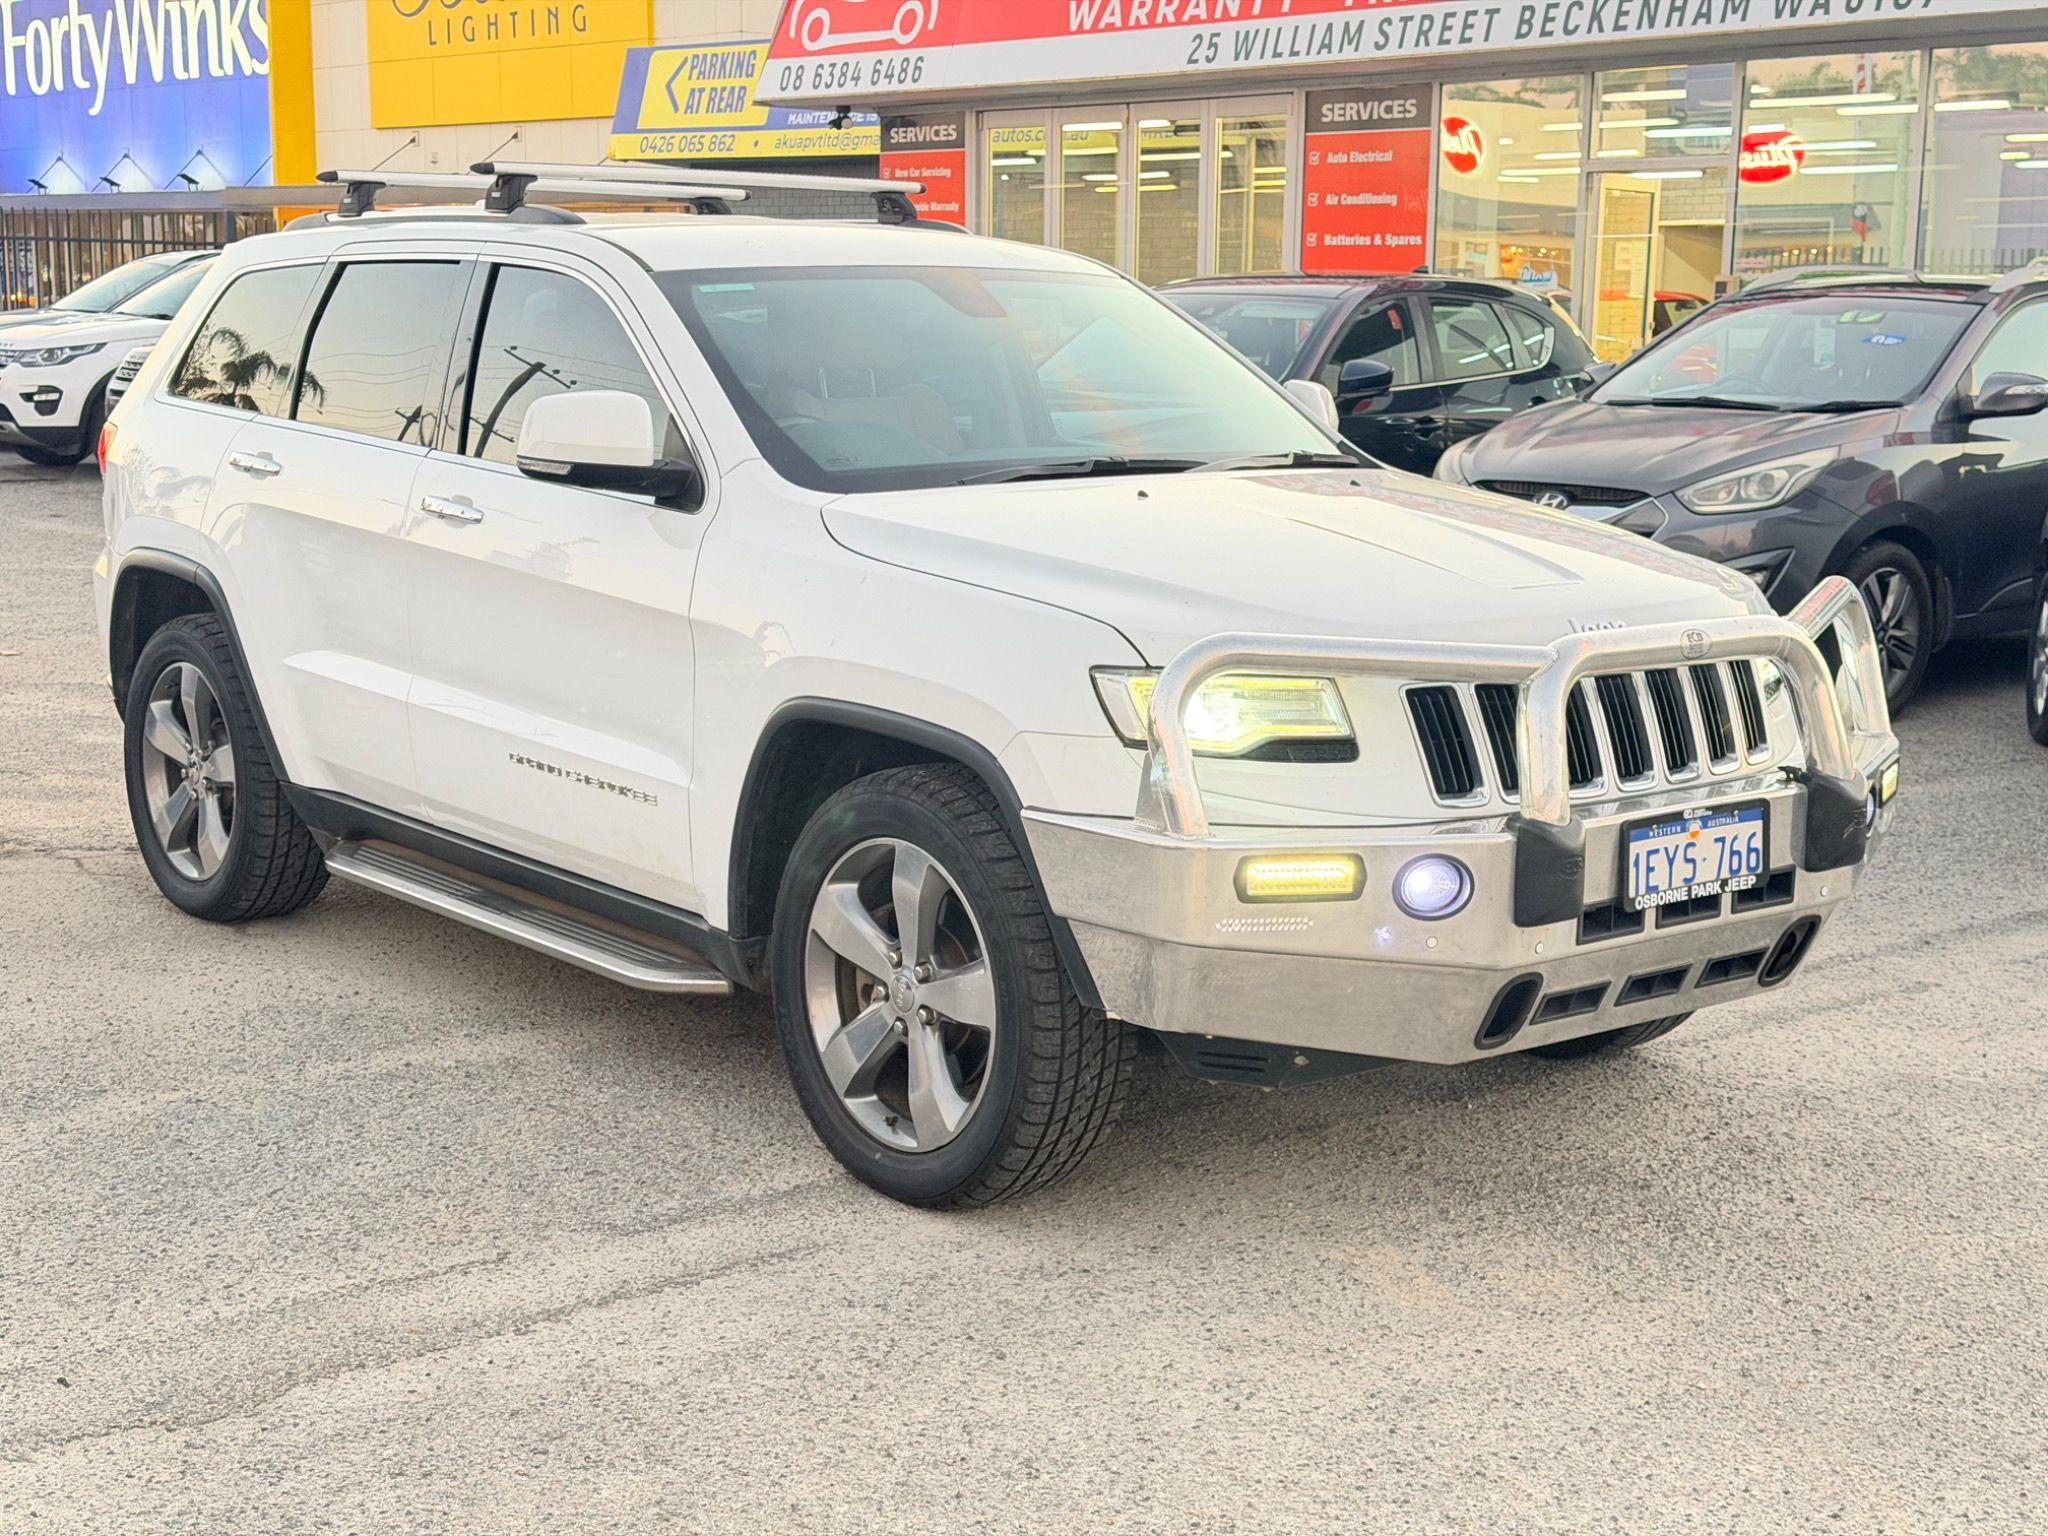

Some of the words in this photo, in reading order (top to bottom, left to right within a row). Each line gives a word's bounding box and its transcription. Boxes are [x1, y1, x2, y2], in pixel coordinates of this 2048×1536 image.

[428, 4, 587, 46] LIGHTING
[1187, 32, 1221, 65] 25
[1233, 19, 1365, 62] WILLIAM
[1373, 8, 1501, 51] STREET
[1514, 0, 1752, 39] BECKENHAM
[688, 50, 757, 81] PARKING
[780, 64, 805, 91] 08
[812, 60, 862, 89] 6384
[870, 56, 924, 86] 6486
[684, 88, 705, 114] AT
[706, 86, 747, 113] REAR
[1321, 99, 1417, 122] SERVICES
[640, 136, 674, 154] 0426
[678, 135, 704, 153] 065
[708, 134, 736, 152] 862
[890, 124, 957, 143] SERVICES
[1326, 151, 1348, 163] Auto
[1350, 150, 1393, 163] Electrical
[1325, 194, 1339, 205] Air
[1341, 193, 1398, 207] Conditioning
[1324, 234, 1371, 246] Batteries
[1373, 234, 1382, 246] &
[1385, 233, 1422, 248] Spares
[1649, 825, 1682, 838] WESTERN
[1707, 815, 1740, 828] AUSTRALIA
[1635, 887, 1689, 911] OSBORNE
[1691, 881, 1723, 899] PARK
[1724, 875, 1757, 893] JEEP
